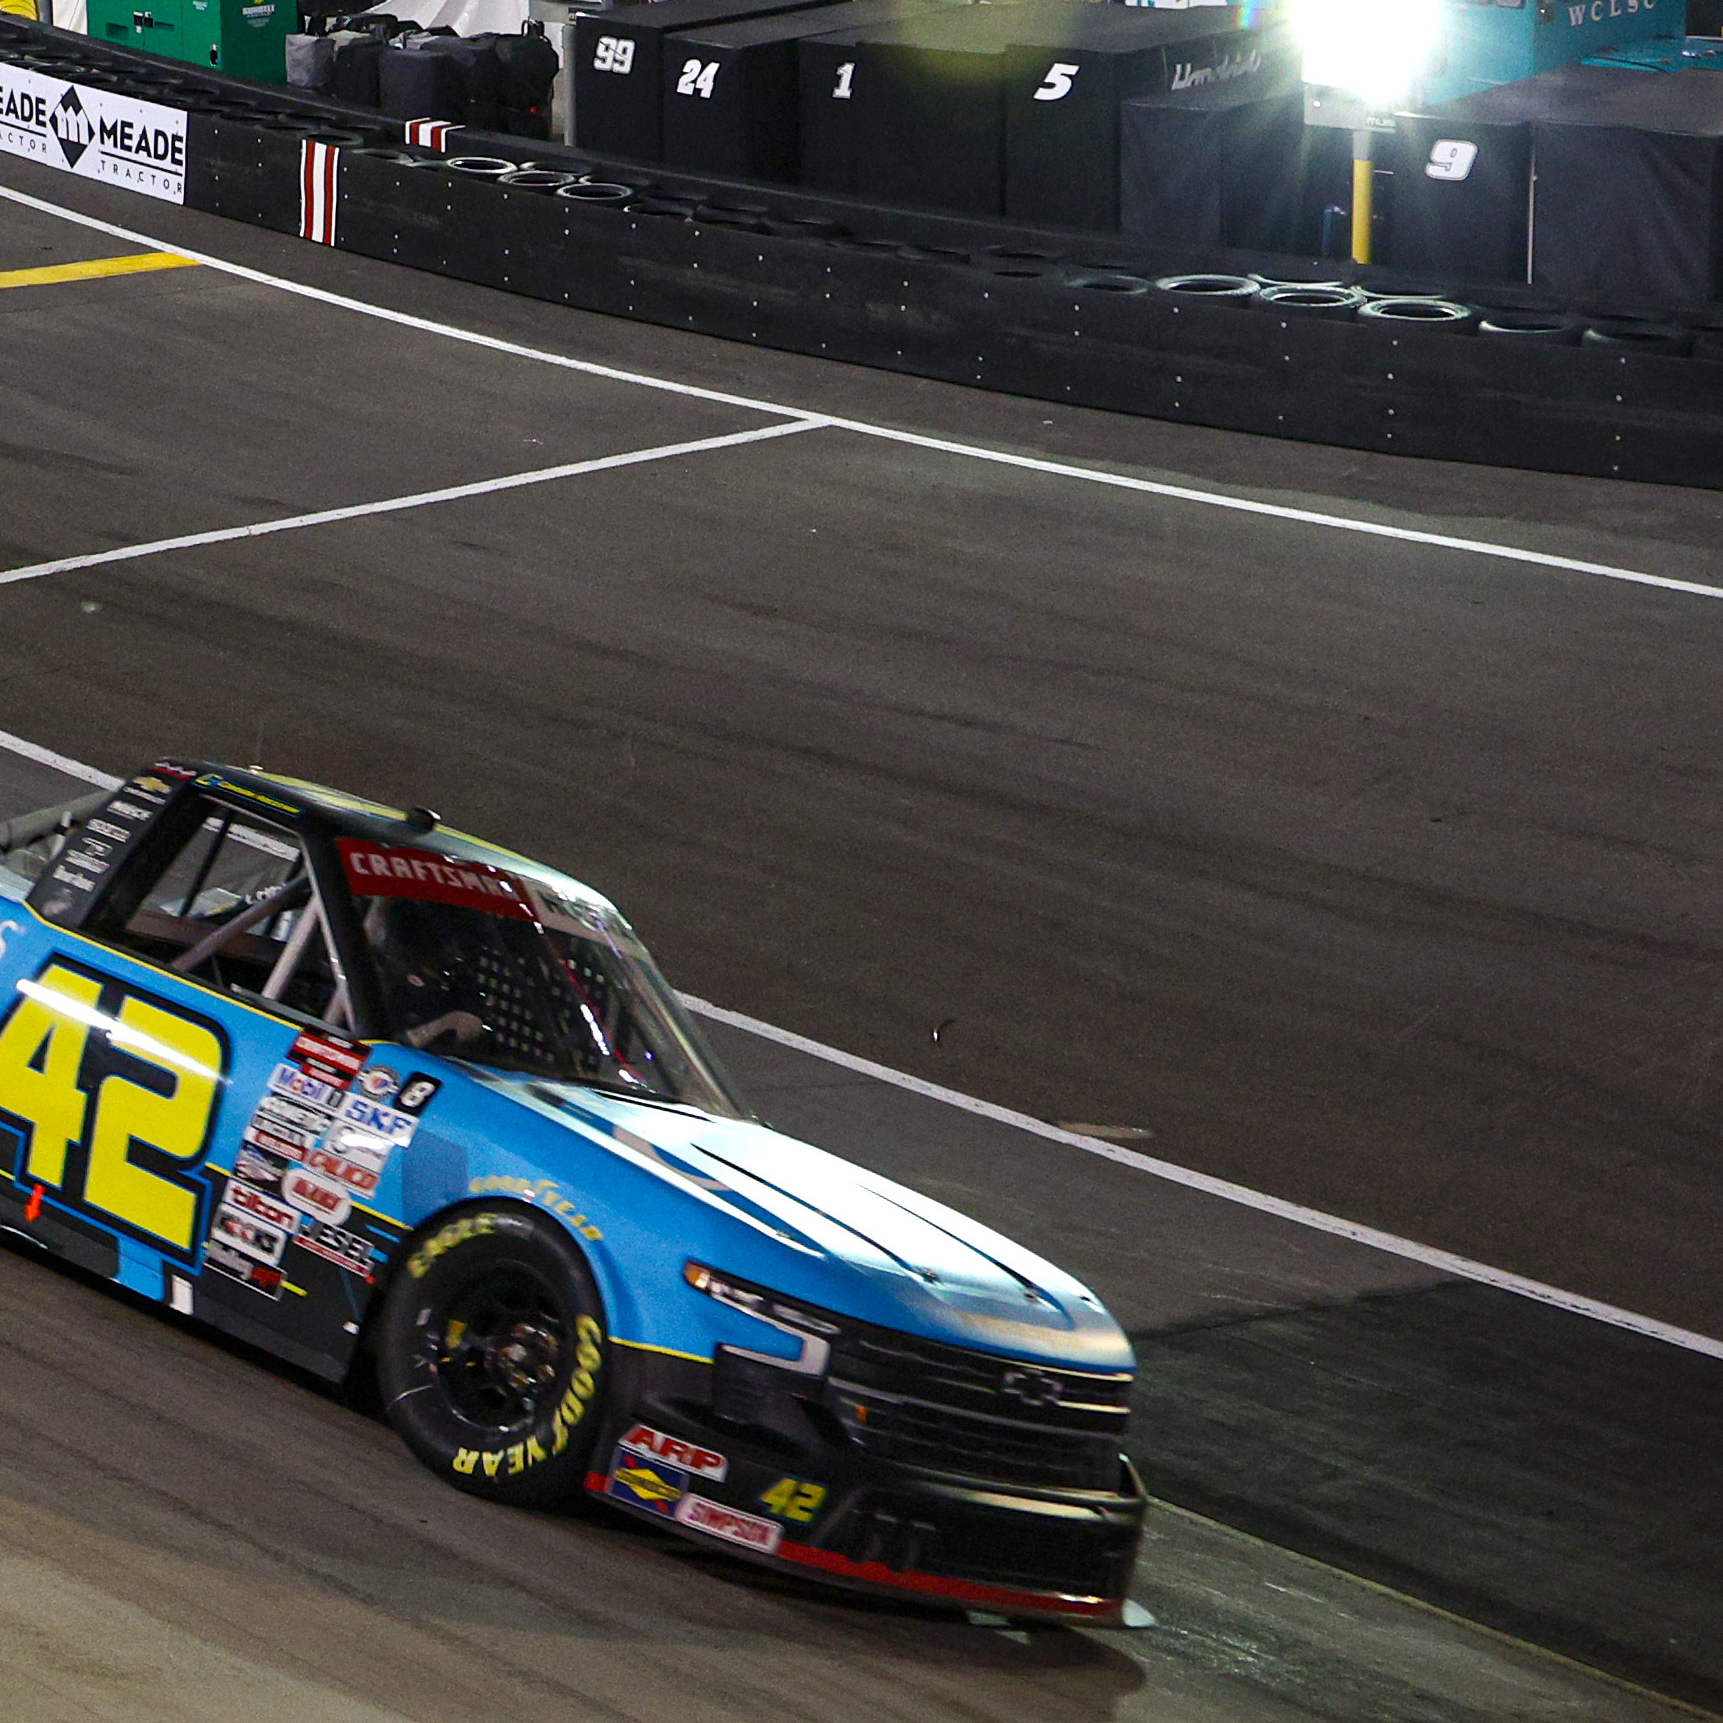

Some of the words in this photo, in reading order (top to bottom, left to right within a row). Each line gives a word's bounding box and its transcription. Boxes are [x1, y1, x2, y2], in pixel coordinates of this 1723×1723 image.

[593, 35, 637, 75] 99
[675, 58, 722, 99] 24
[1032, 63, 1080, 101] 5
[98, 116, 186, 171] MEADE
[1424, 138, 1479, 181] 9
[99, 158, 184, 197] TRACTOR
[347, 851, 522, 903] CRAFTSMAN
[344, 1097, 415, 1137] SKF
[450, 1312, 604, 1479] GOODYEAR
[623, 1423, 730, 1481] ARP
[682, 1496, 785, 1553] SIMPSON
[759, 1475, 828, 1526] 42
